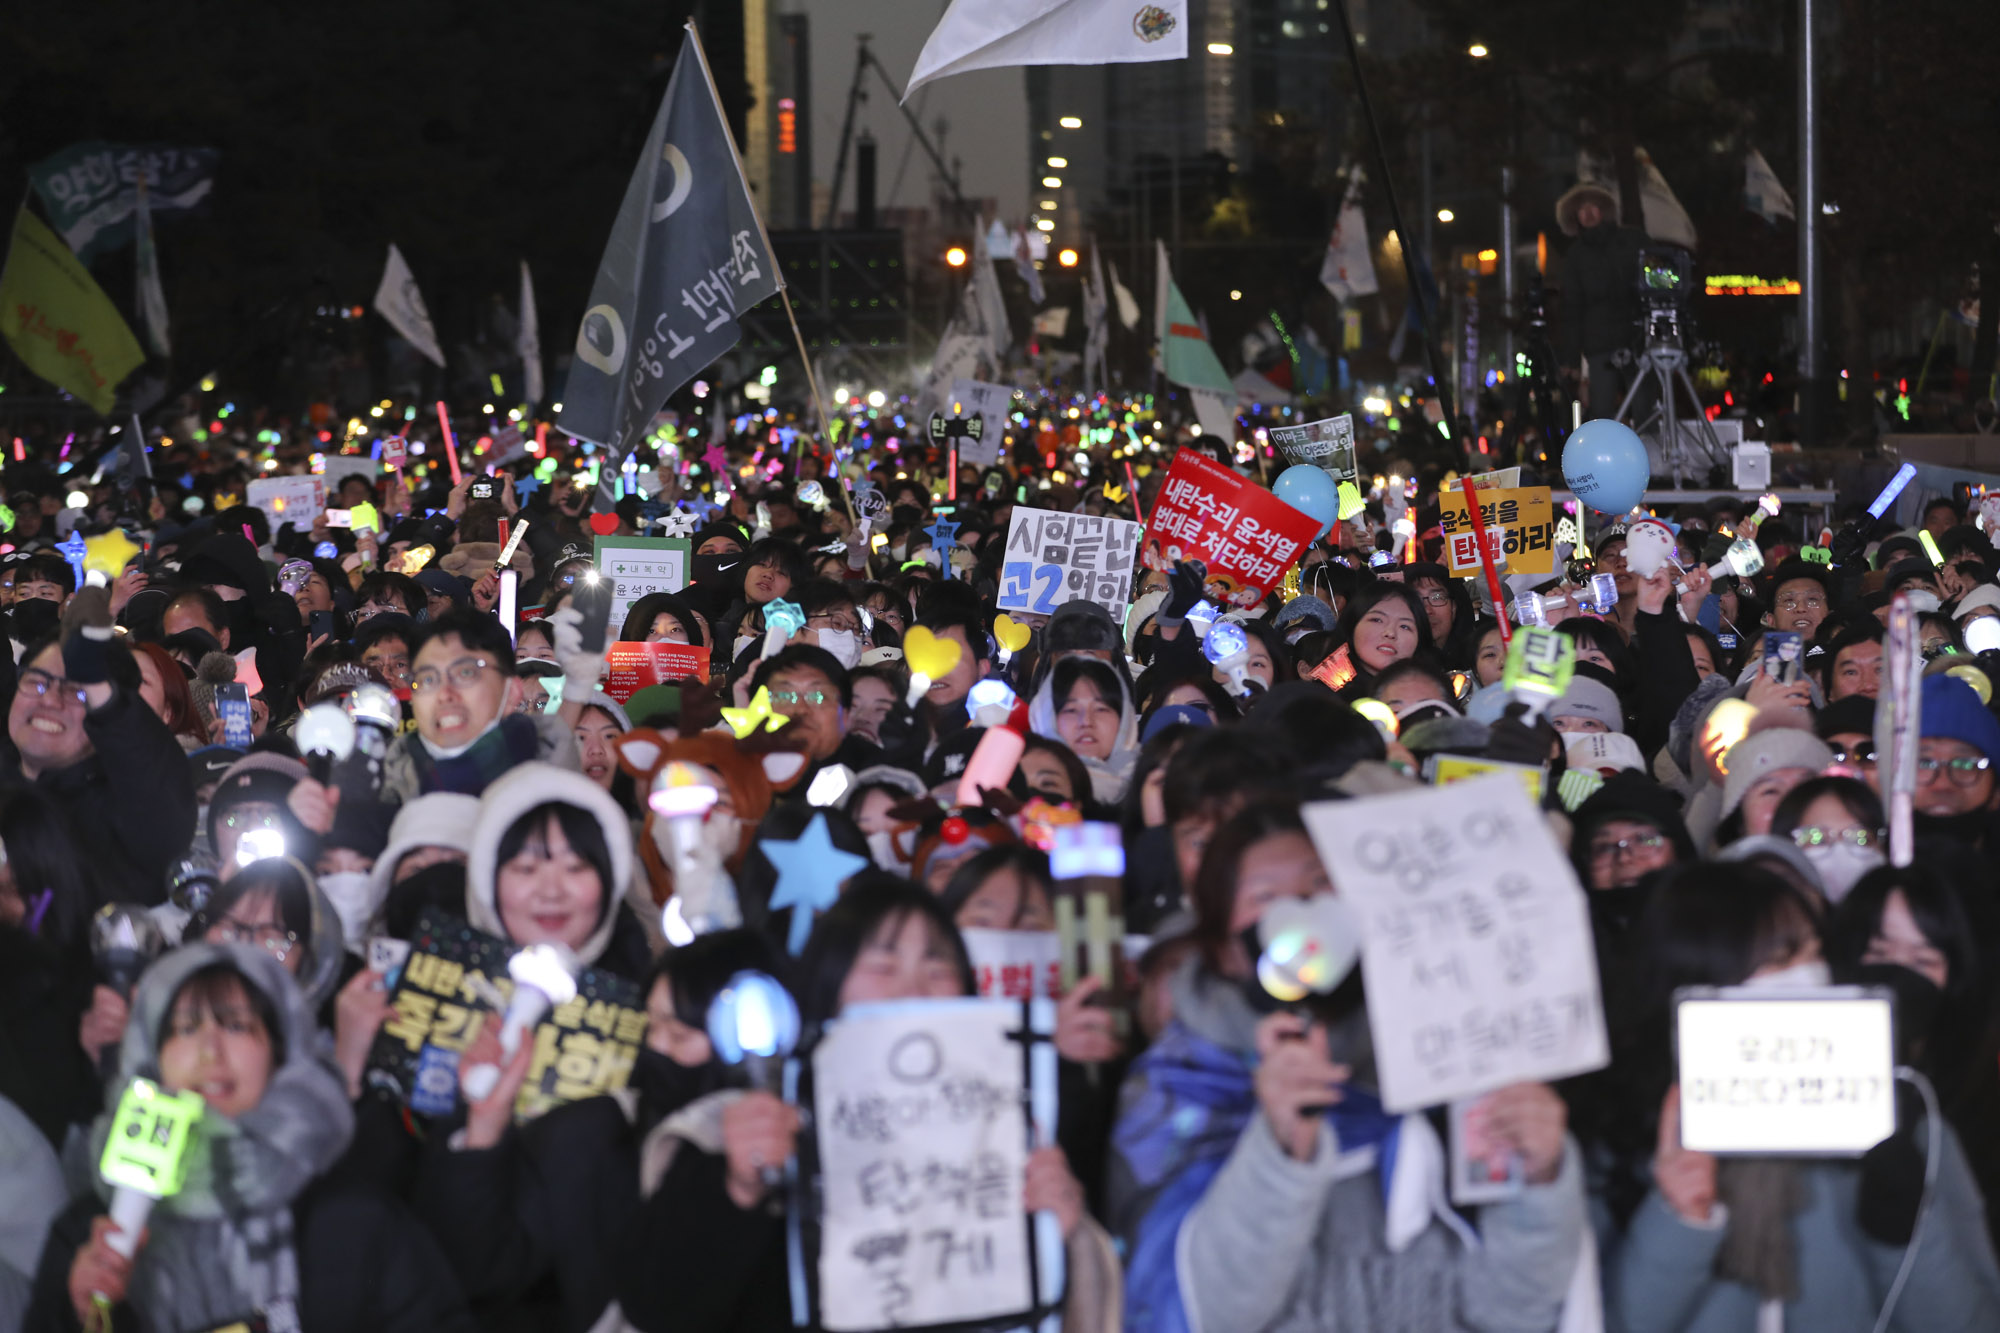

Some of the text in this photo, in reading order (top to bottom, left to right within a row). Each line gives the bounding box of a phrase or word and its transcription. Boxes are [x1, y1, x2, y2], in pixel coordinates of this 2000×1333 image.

[1153, 505, 1283, 585] 법대로 처단하라
[1164, 478, 1299, 563] 내란수괴 윤석열
[1610, 523, 1626, 535] NY
[1000, 561, 1063, 615] 고2
[1524, 631, 1566, 679] 탄
